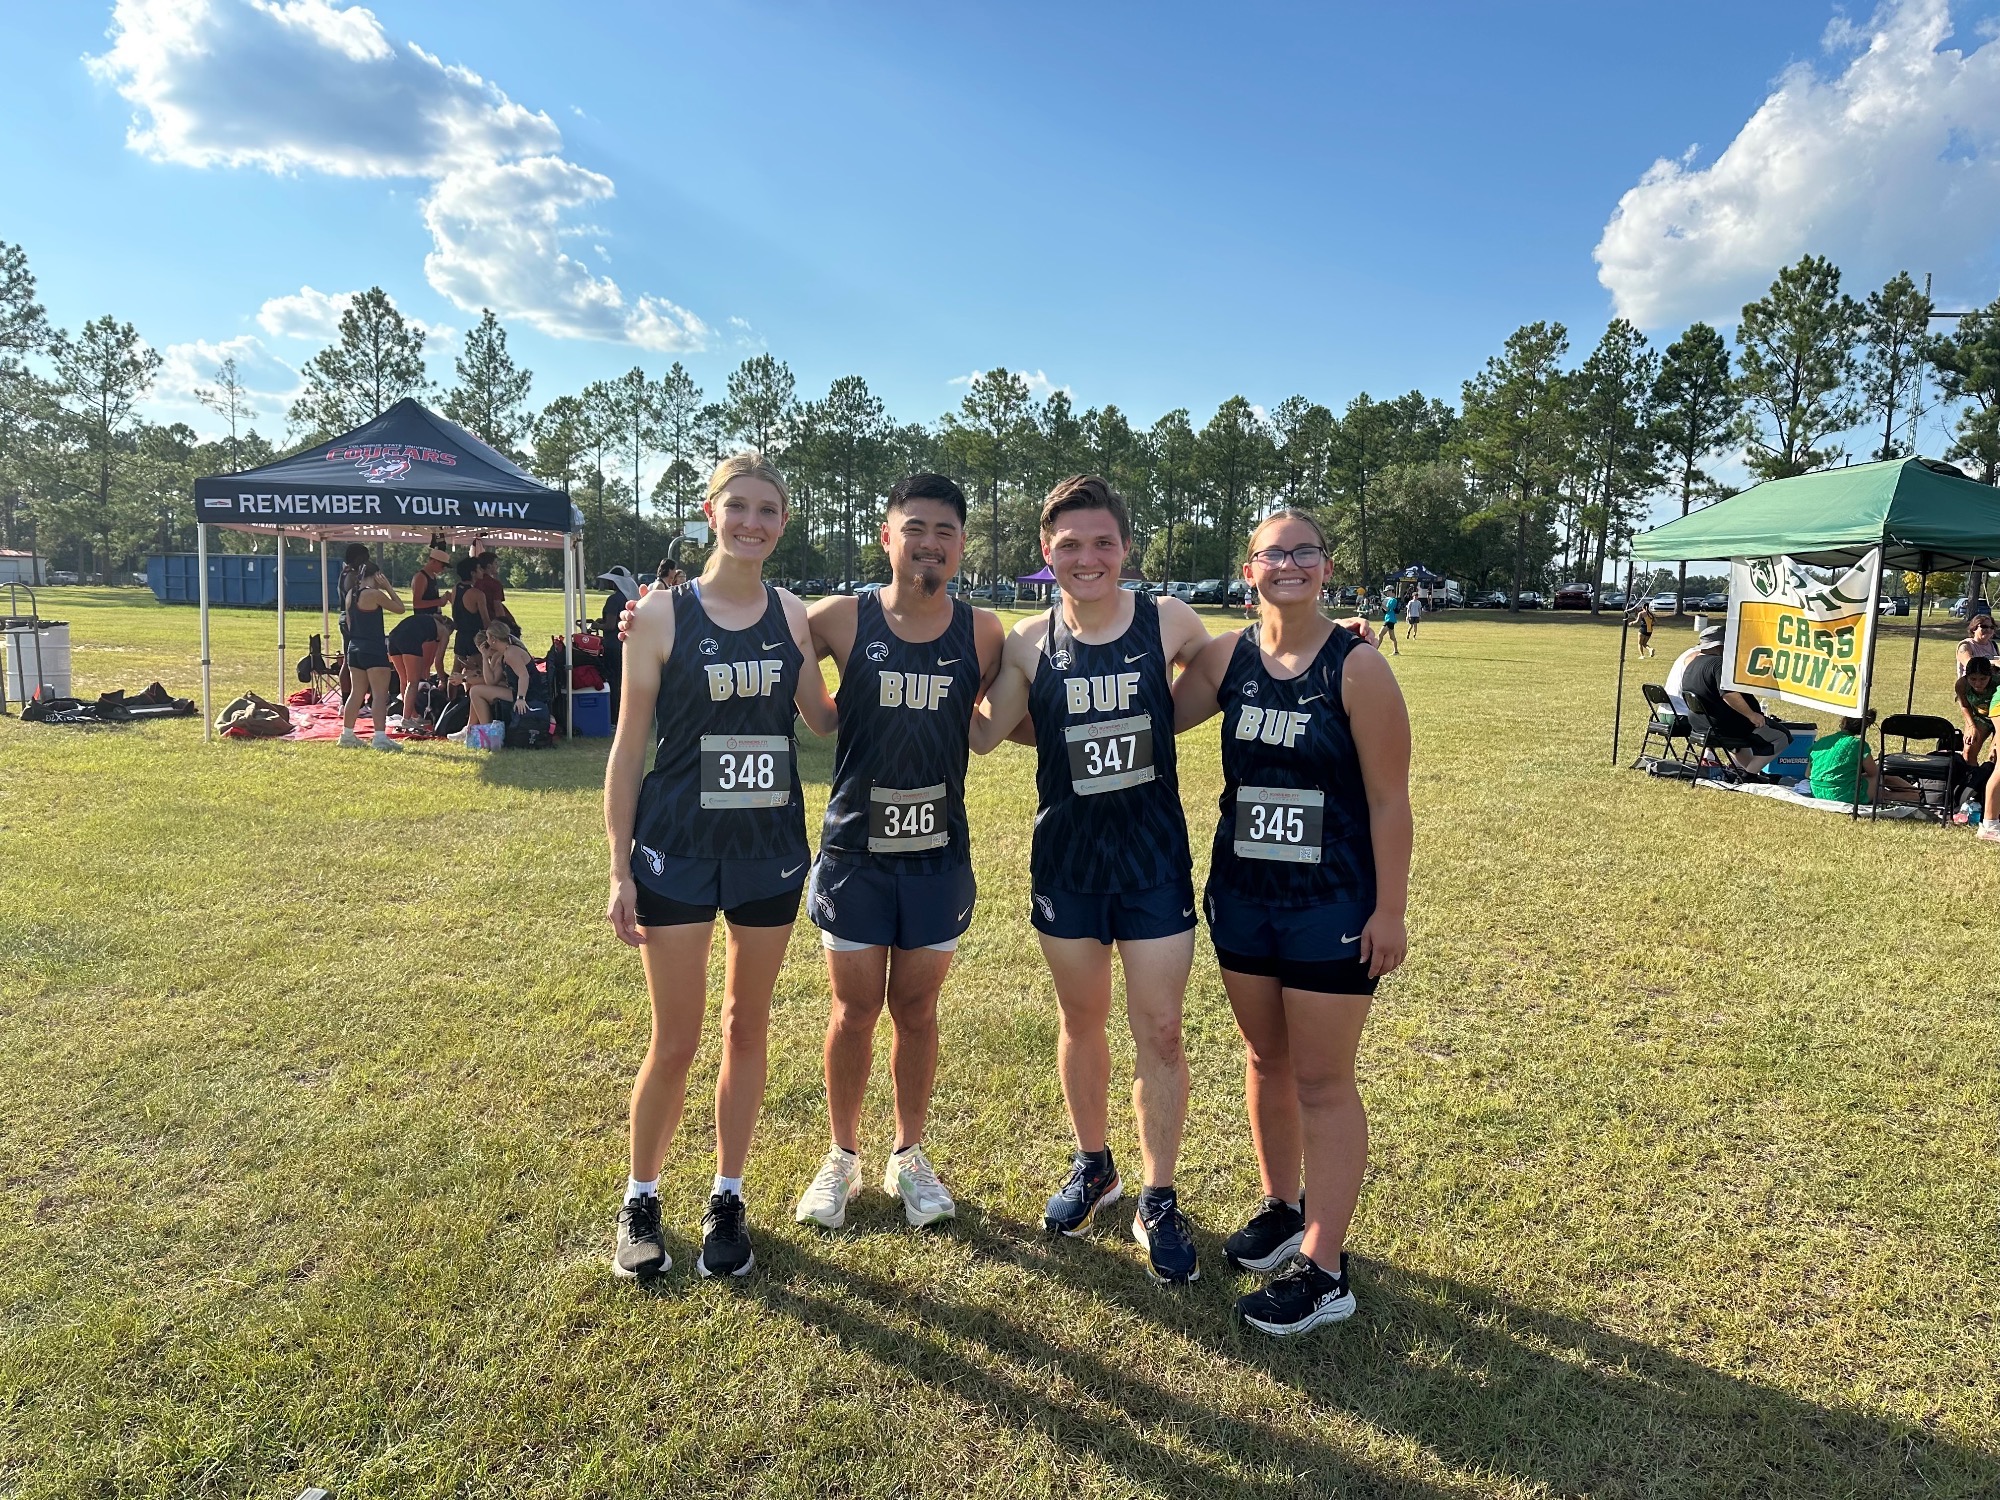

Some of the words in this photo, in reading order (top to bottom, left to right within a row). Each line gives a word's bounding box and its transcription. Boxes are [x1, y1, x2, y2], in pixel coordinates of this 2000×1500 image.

[326, 446, 458, 466] COUGARS
[404, 444, 442, 453] UNIVERSITY
[238, 493, 382, 514] REMEMBER
[394, 494, 461, 516] YOUR
[473, 500, 531, 520] WHY
[703, 660, 783, 701] BUF
[878, 670, 954, 711] BUF
[1746, 646, 1862, 697] COUNTR
[1063, 671, 1141, 714] BUF
[1235, 704, 1312, 748] BUF
[719, 753, 774, 790] 348
[1084, 735, 1137, 775] 347
[884, 803, 935, 837] 346
[1249, 804, 1304, 843] 345
